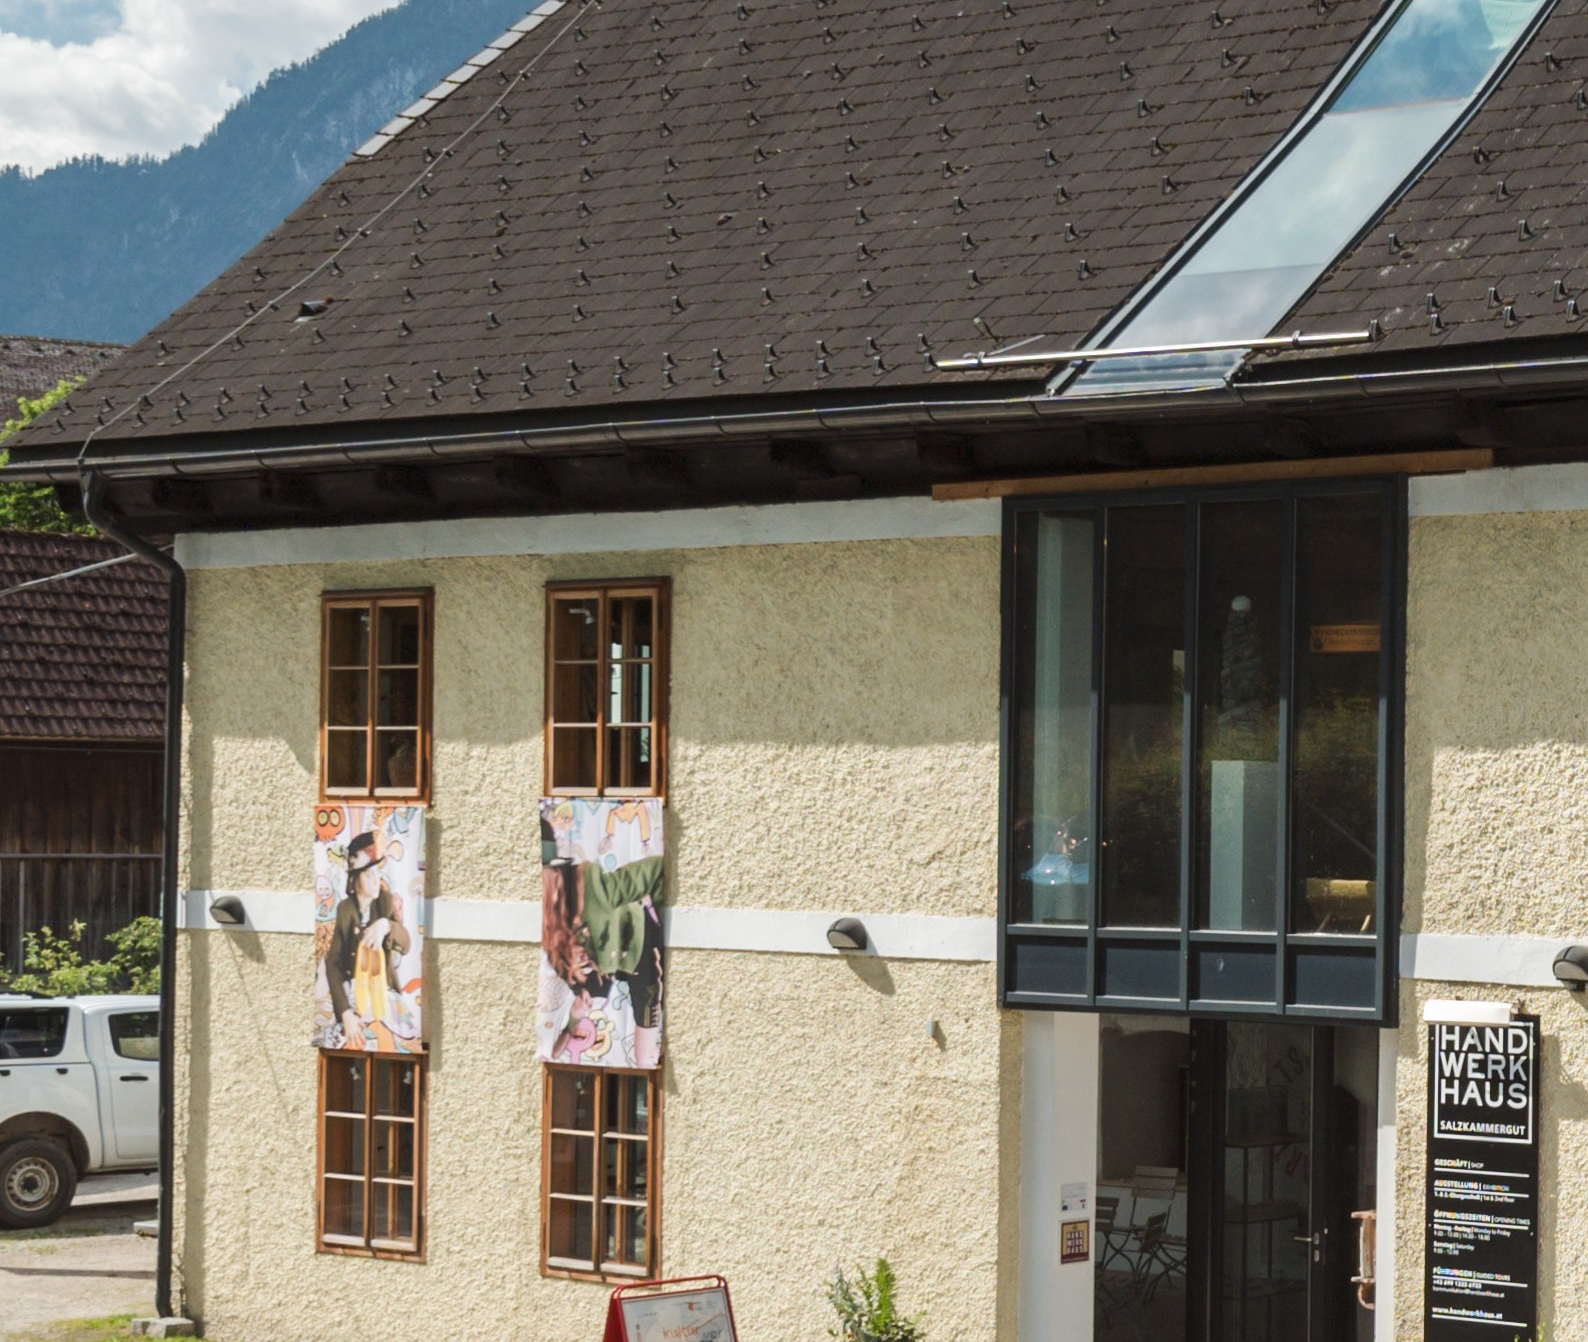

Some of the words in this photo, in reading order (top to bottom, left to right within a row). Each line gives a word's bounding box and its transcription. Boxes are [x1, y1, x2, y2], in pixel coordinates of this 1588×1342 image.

[1440, 1025, 1528, 1054] HAND
[1439, 1051, 1528, 1081] WERK
[1440, 1078, 1528, 1110] HAUS
[1440, 1120, 1526, 1135] SALZKAMMERGUT
